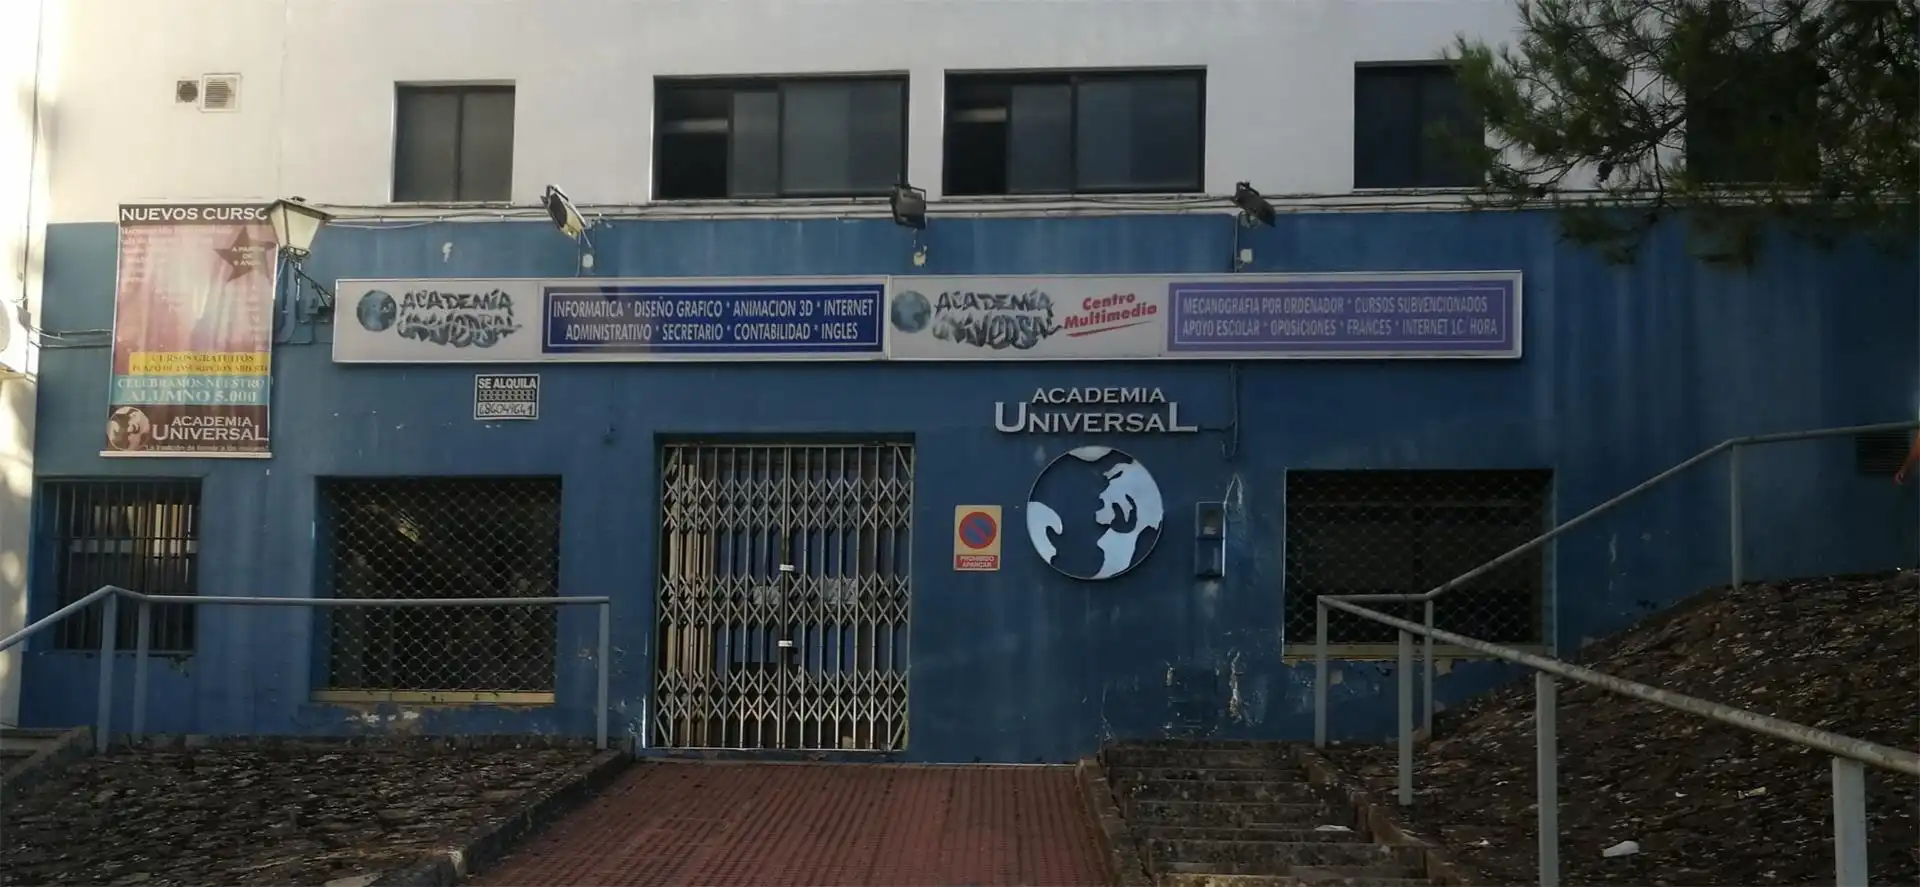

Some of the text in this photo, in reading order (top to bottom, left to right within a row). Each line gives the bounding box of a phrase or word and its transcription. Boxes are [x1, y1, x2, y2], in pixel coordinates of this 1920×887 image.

[121, 207, 198, 221] NUEVOS
[553, 296, 874, 317] INFORMATICA DISEÑO GRAFICO ANIMACION 3D INTERNET
[1082, 291, 1136, 311] Centro
[1183, 296, 1487, 314] MECANOGRAFIA POR ORDENADOR CURSOS SUBVENCIONADOS
[1063, 303, 1158, 329] Multimedia
[565, 322, 858, 341] ADMINISTRATIVO SECRETARIO CONTABILIDAD INGLES
[1182, 319, 1214, 336] APOYO
[1216, 319, 1259, 336] ESCOLAR
[1270, 319, 1336, 336] OPOSICIONES
[1347, 319, 1391, 335] FRANCES
[1402, 318, 1448, 335] INTERNET
[1470, 318, 1497, 335] HORA
[478, 377, 537, 389] SE ALQUILA
[129, 389, 257, 402] ALUMNO 5.000
[1031, 387, 1166, 404] ACADEMIA
[171, 416, 253, 427] ACADEMIA
[994, 401, 1198, 433] UNIVERSAL
[152, 424, 269, 441] UNIVERSAL
